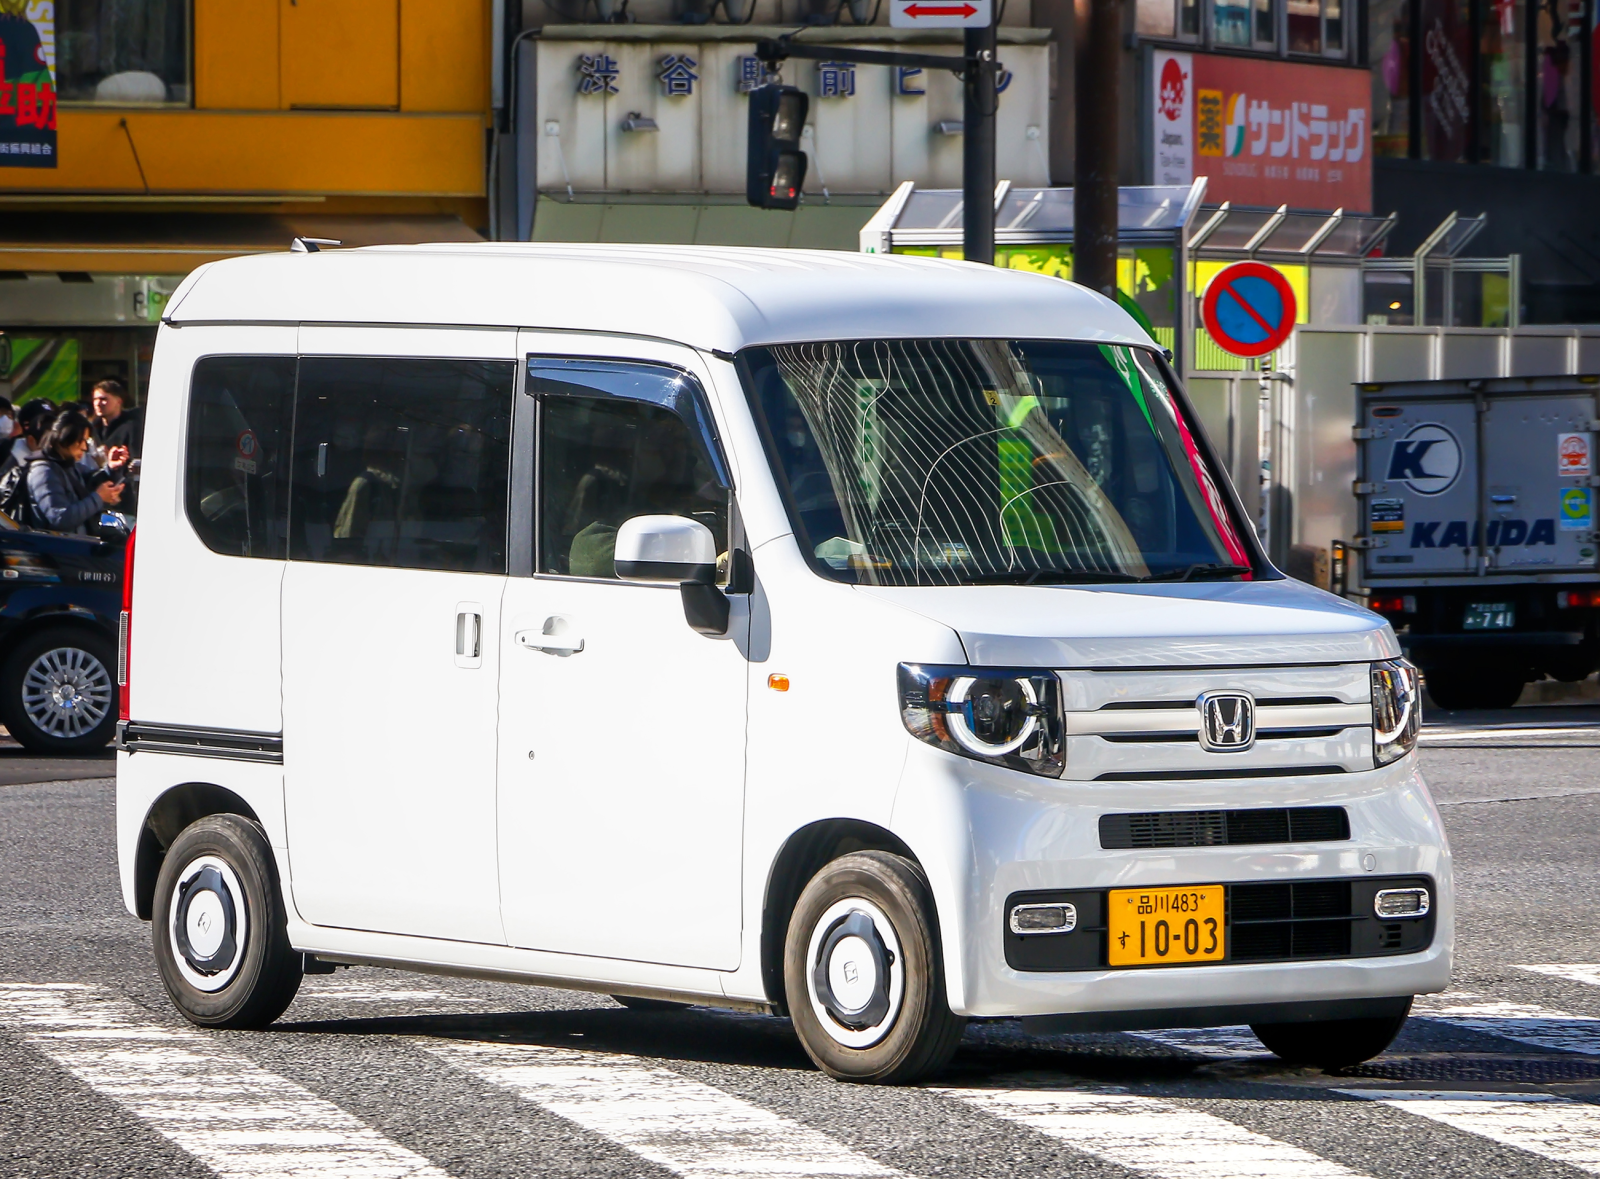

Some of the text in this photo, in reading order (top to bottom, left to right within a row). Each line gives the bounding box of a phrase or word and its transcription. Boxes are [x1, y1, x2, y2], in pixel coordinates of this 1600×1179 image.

[1248, 100, 1366, 163] サンドラッグ
[1410, 519, 1556, 548] KANDA
[1117, 917, 1218, 958] す 10-03
